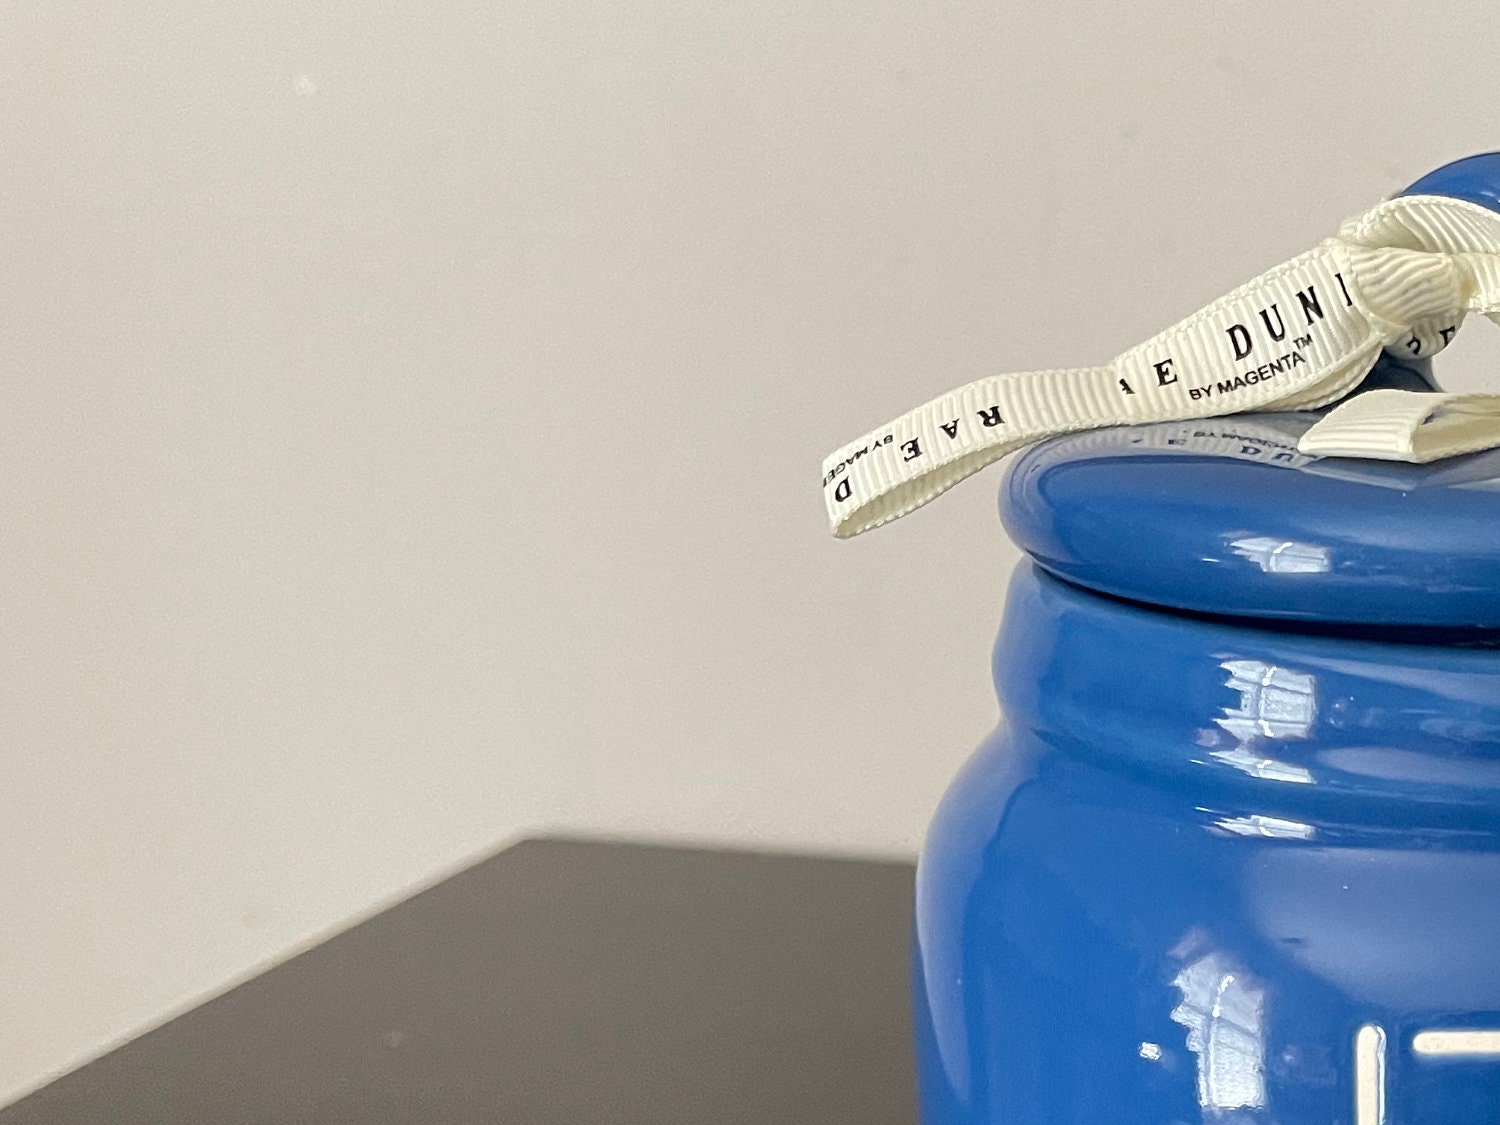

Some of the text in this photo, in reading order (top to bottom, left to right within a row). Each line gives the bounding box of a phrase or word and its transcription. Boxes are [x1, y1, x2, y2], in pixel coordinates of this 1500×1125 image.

[1189, 384, 1213, 401] BY
[872, 434, 893, 451] BY
[900, 406, 1005, 462] RAE
